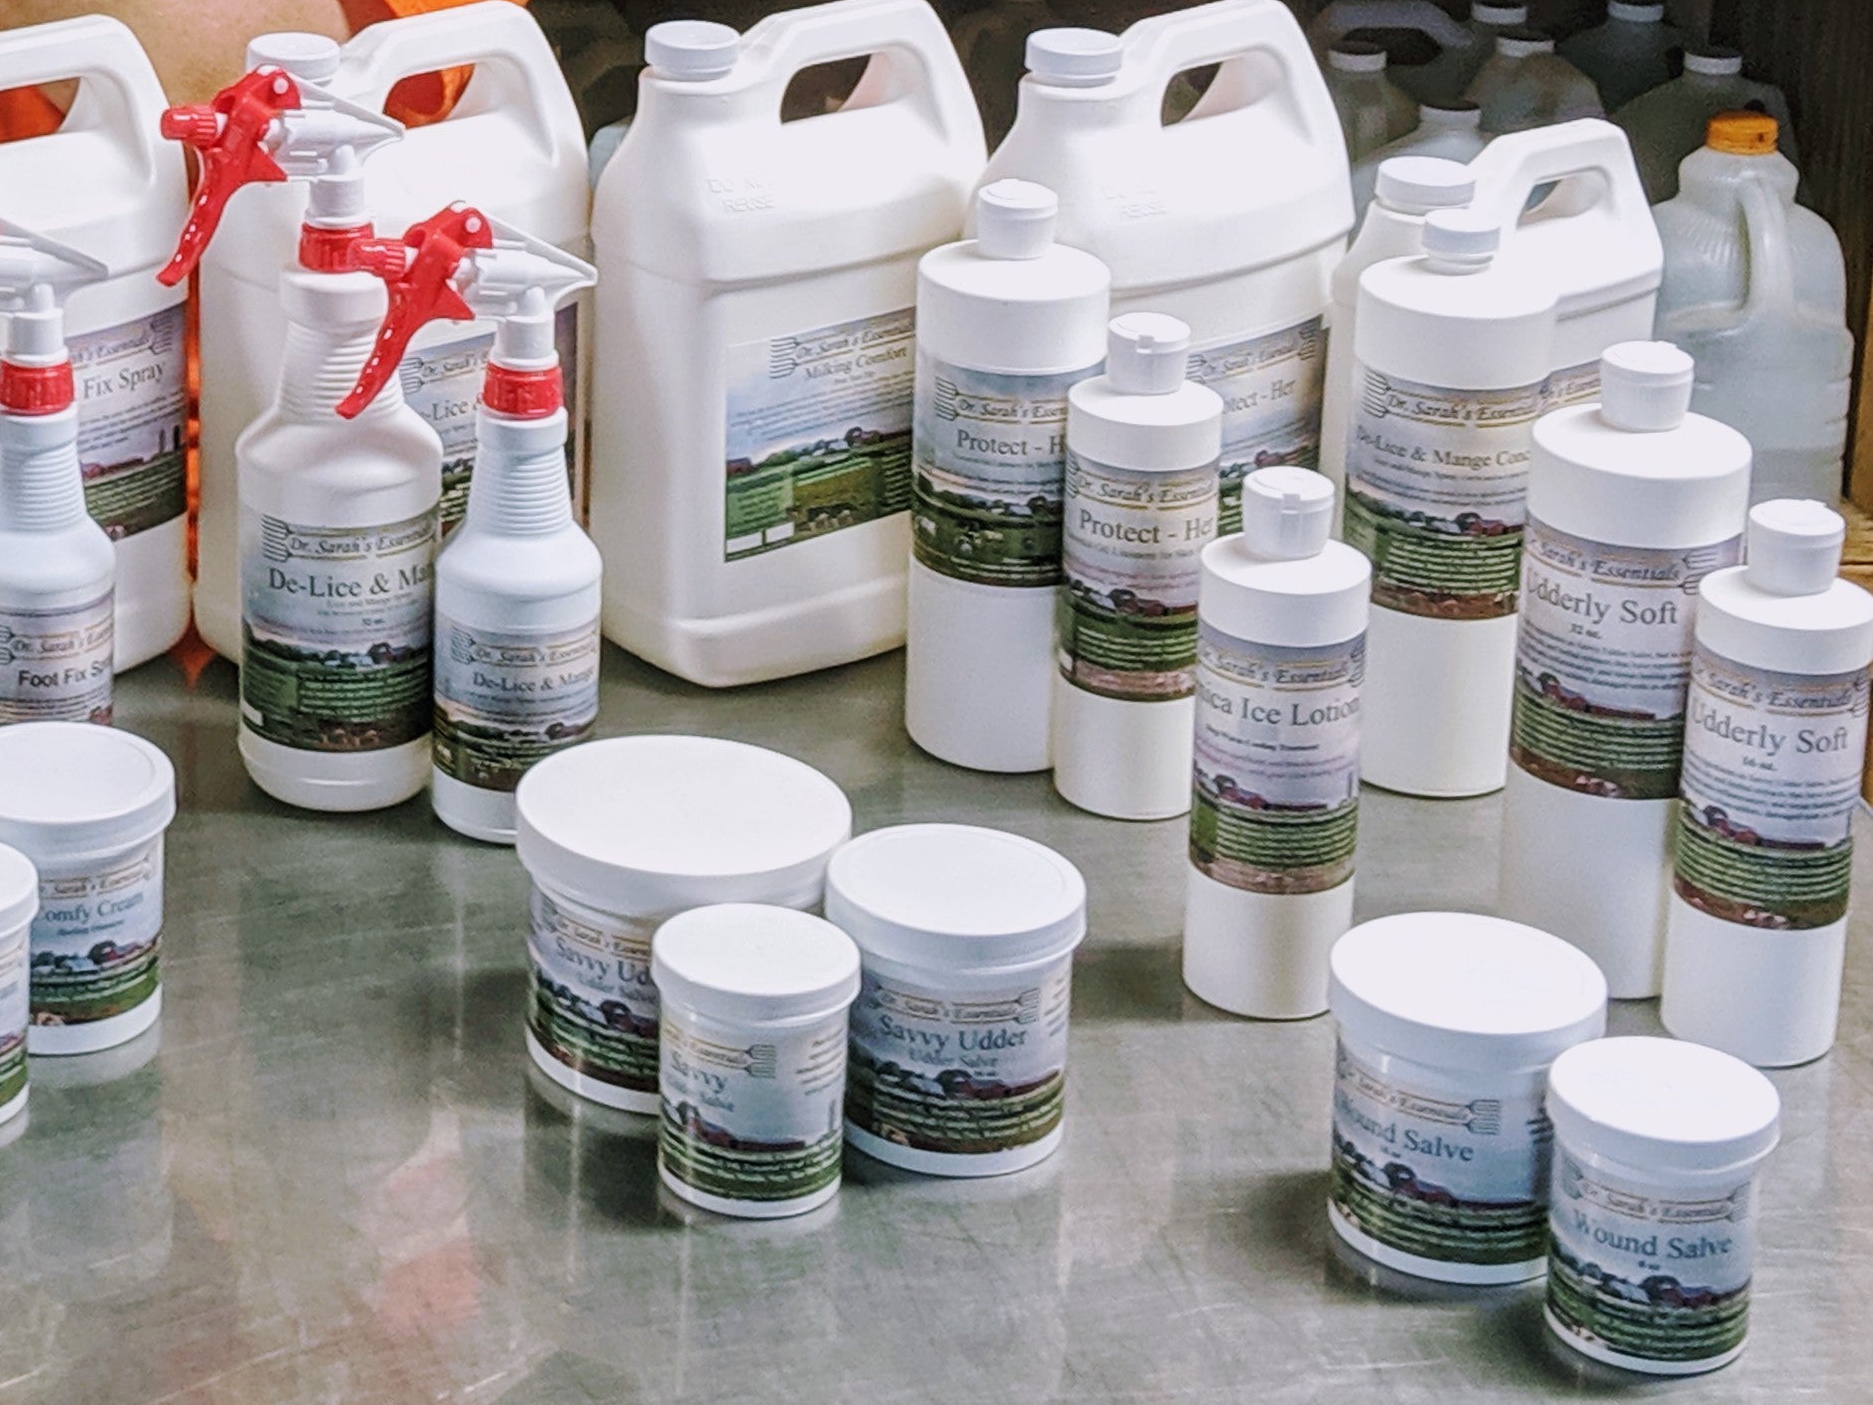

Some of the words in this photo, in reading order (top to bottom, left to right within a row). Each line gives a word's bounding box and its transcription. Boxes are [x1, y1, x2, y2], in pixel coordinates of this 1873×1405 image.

[83, 374, 114, 400] Fix
[118, 360, 167, 392] Spray
[957, 429, 1027, 455] Protect
[1411, 446, 1427, 462] &
[1433, 449, 1493, 471] Mange
[1098, 481, 1154, 504] Sarah's
[1078, 507, 1161, 544] Protect
[290, 536, 313, 552] Dr.
[315, 536, 372, 555] Sarah's
[268, 567, 362, 599] De-Lice
[368, 572, 391, 595] &
[1591, 559, 1680, 581] Essentials
[1526, 567, 1611, 625] Udderly
[1619, 599, 1678, 626] Soft
[18, 669, 58, 688] Foot
[63, 667, 87, 685] Fix
[473, 671, 537, 693] De-Lice
[541, 677, 554, 692] &
[1707, 671, 1763, 703] Sarah's
[1768, 689, 1852, 708] Essentials
[1241, 697, 1282, 725] Ice
[1291, 696, 1361, 727] Lotion
[1692, 698, 1787, 757] Udderly
[1795, 726, 1849, 755] Soft
[556, 936, 611, 981] Savvy
[879, 1015, 951, 1052] Savvy
[958, 1030, 1028, 1052] Udder
[1403, 1129, 1475, 1162] Salve
[1573, 1208, 1659, 1256] Wound
[1667, 1231, 1734, 1259] Salve
